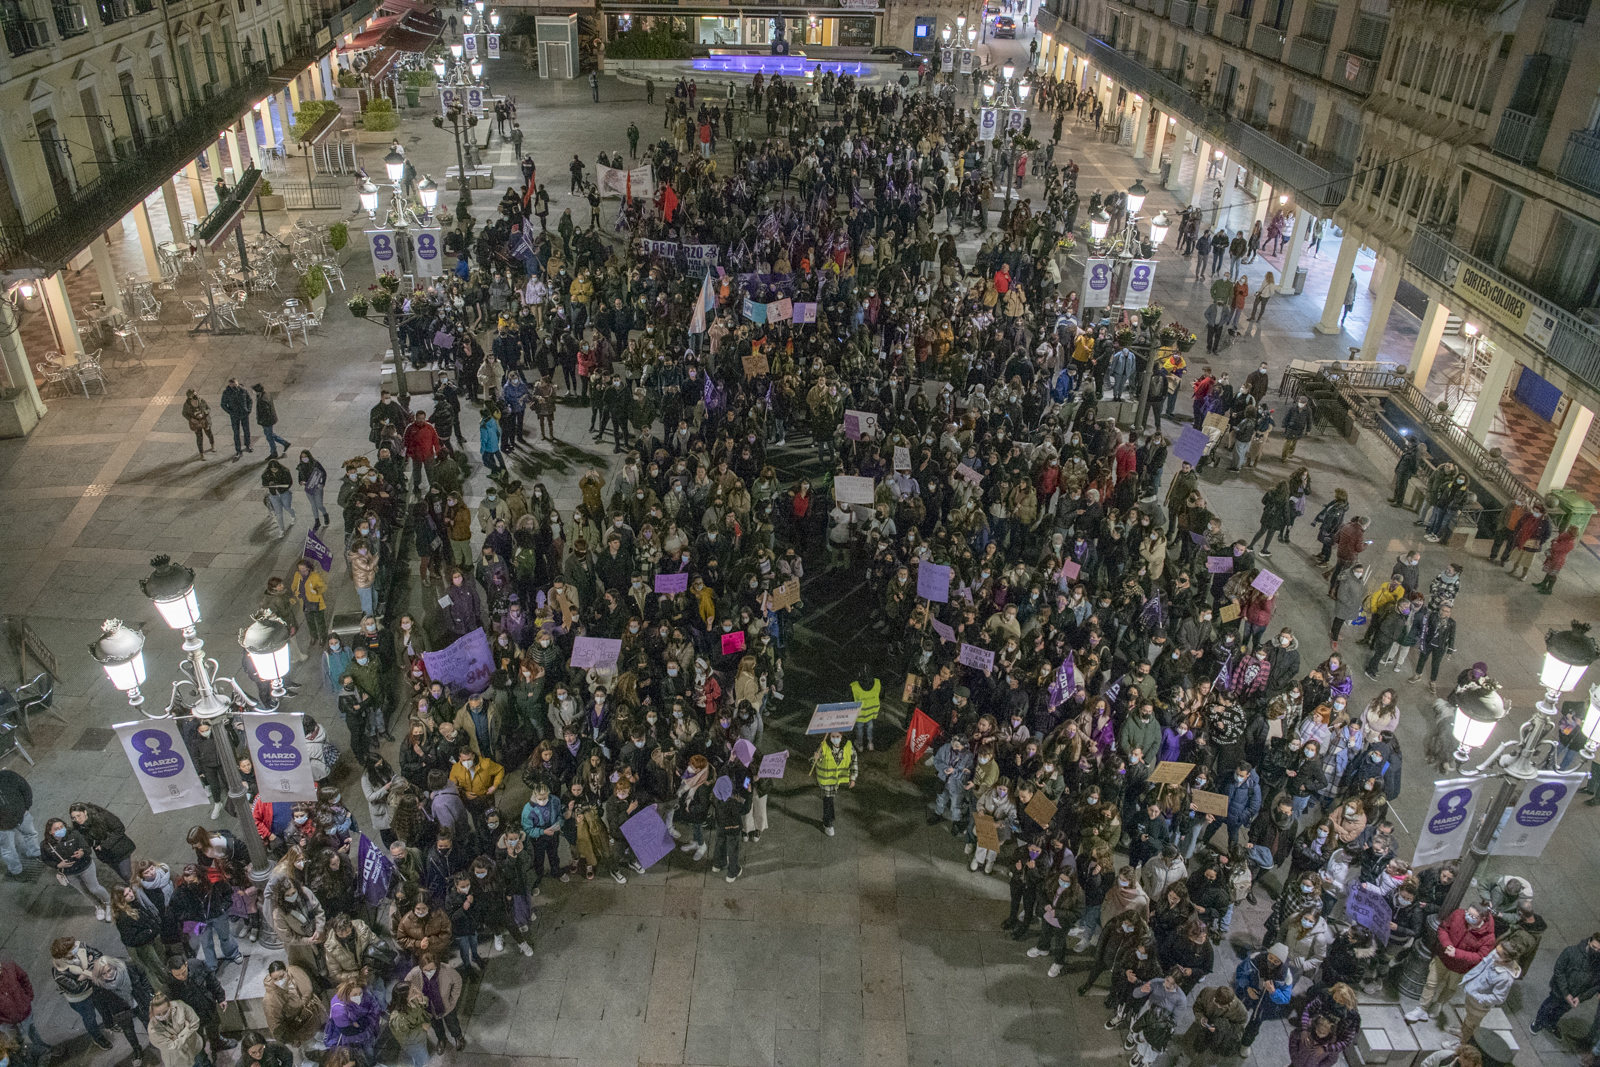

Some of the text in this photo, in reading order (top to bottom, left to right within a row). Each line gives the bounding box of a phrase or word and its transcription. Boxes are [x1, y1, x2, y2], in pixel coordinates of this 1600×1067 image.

[667, 243, 704, 259] MRZO
[466, 663, 490, 684] 8M
[143, 757, 178, 768] MARZO
[1433, 814, 1463, 825] MARZO
